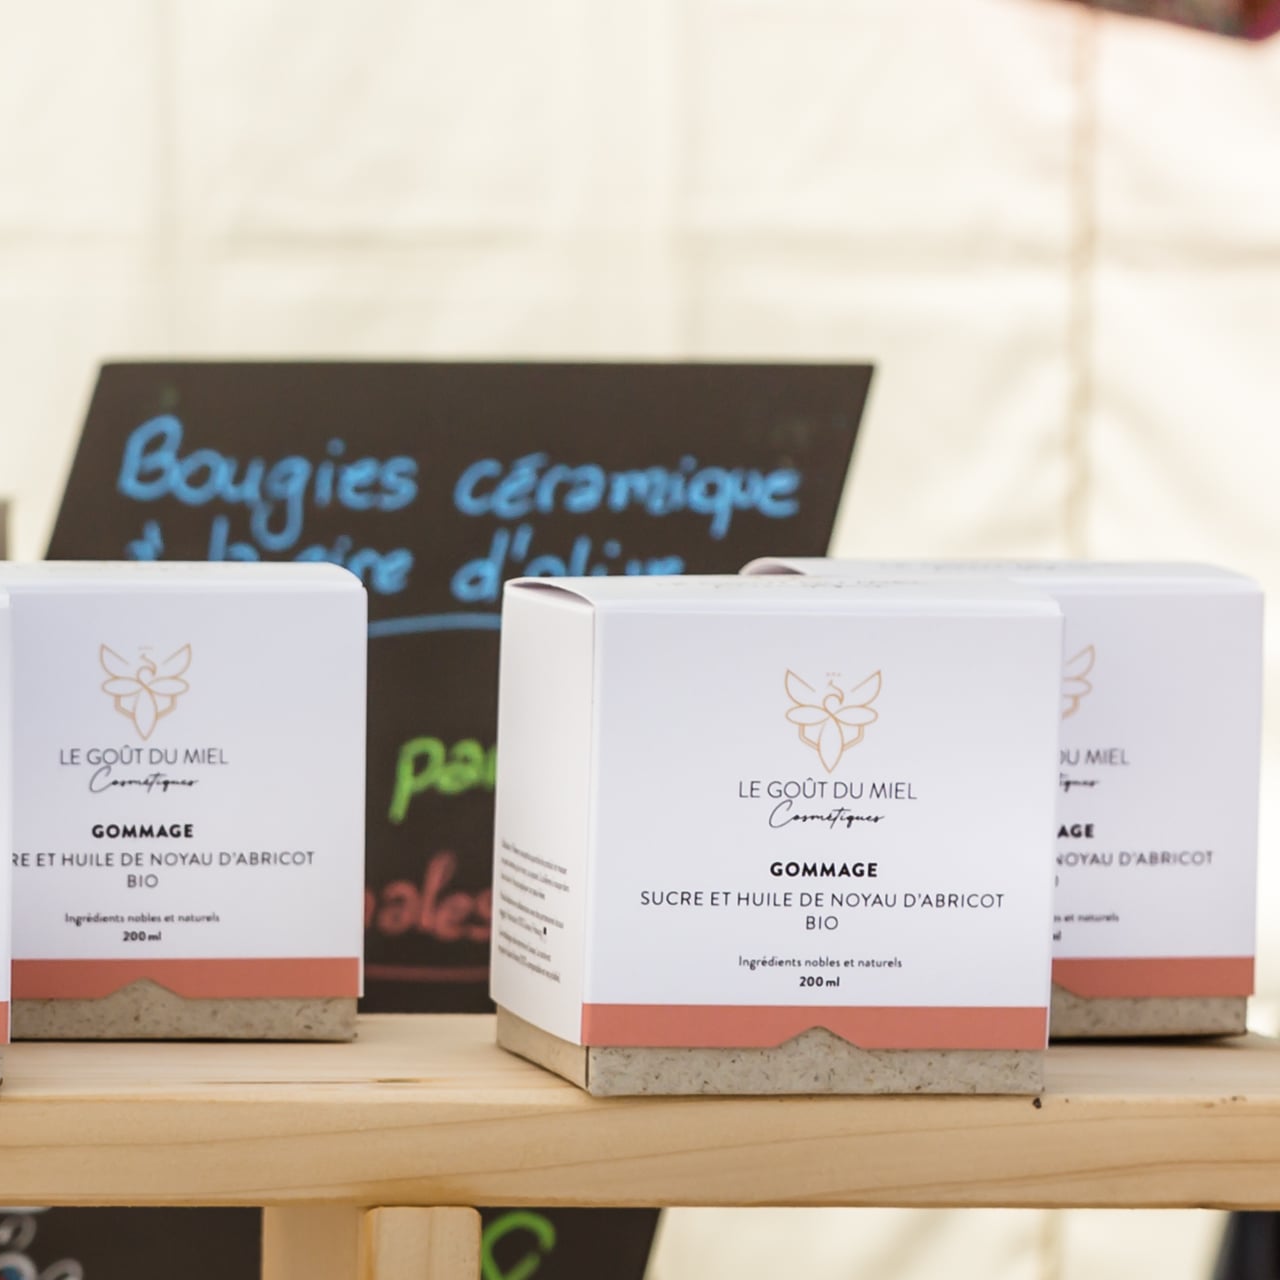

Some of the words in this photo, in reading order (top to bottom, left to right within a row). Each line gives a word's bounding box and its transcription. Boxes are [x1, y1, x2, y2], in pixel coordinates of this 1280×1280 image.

[119, 416, 419, 552] Bougies
[453, 452, 802, 539] céramique
[769, 861, 878, 878] GOMMAGE
[640, 890, 704, 907] SUCRE
[709, 890, 732, 907] ET
[736, 891, 793, 907] HUILE
[799, 891, 824, 908] DE
[830, 892, 897, 908] NOYAU
[903, 892, 1004, 909] D'ABRICOT
[805, 915, 839, 931] BIO
